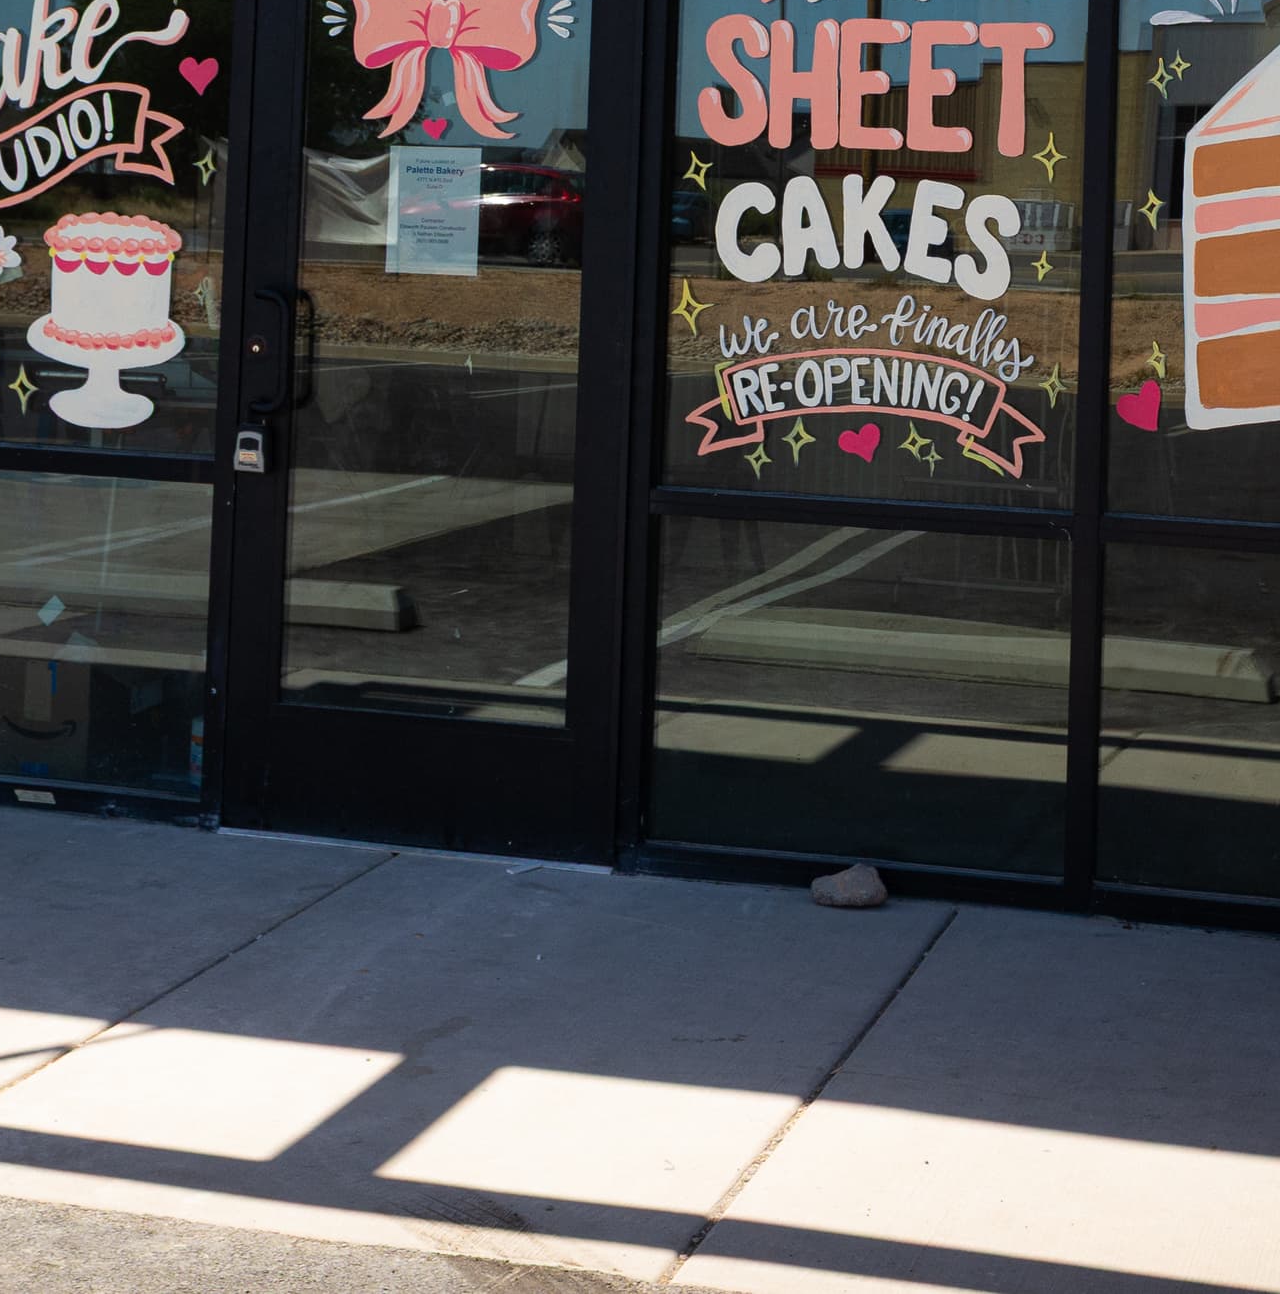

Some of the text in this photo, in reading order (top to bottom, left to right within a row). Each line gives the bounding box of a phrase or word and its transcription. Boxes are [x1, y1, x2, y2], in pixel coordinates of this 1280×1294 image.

[697, 13, 1055, 157] SHEET
[406, 165, 465, 177] Palette Bakery
[714, 173, 1021, 301] CAKES
[720, 295, 1034, 382] we are finally
[732, 357, 985, 422] RE-OPENING!
